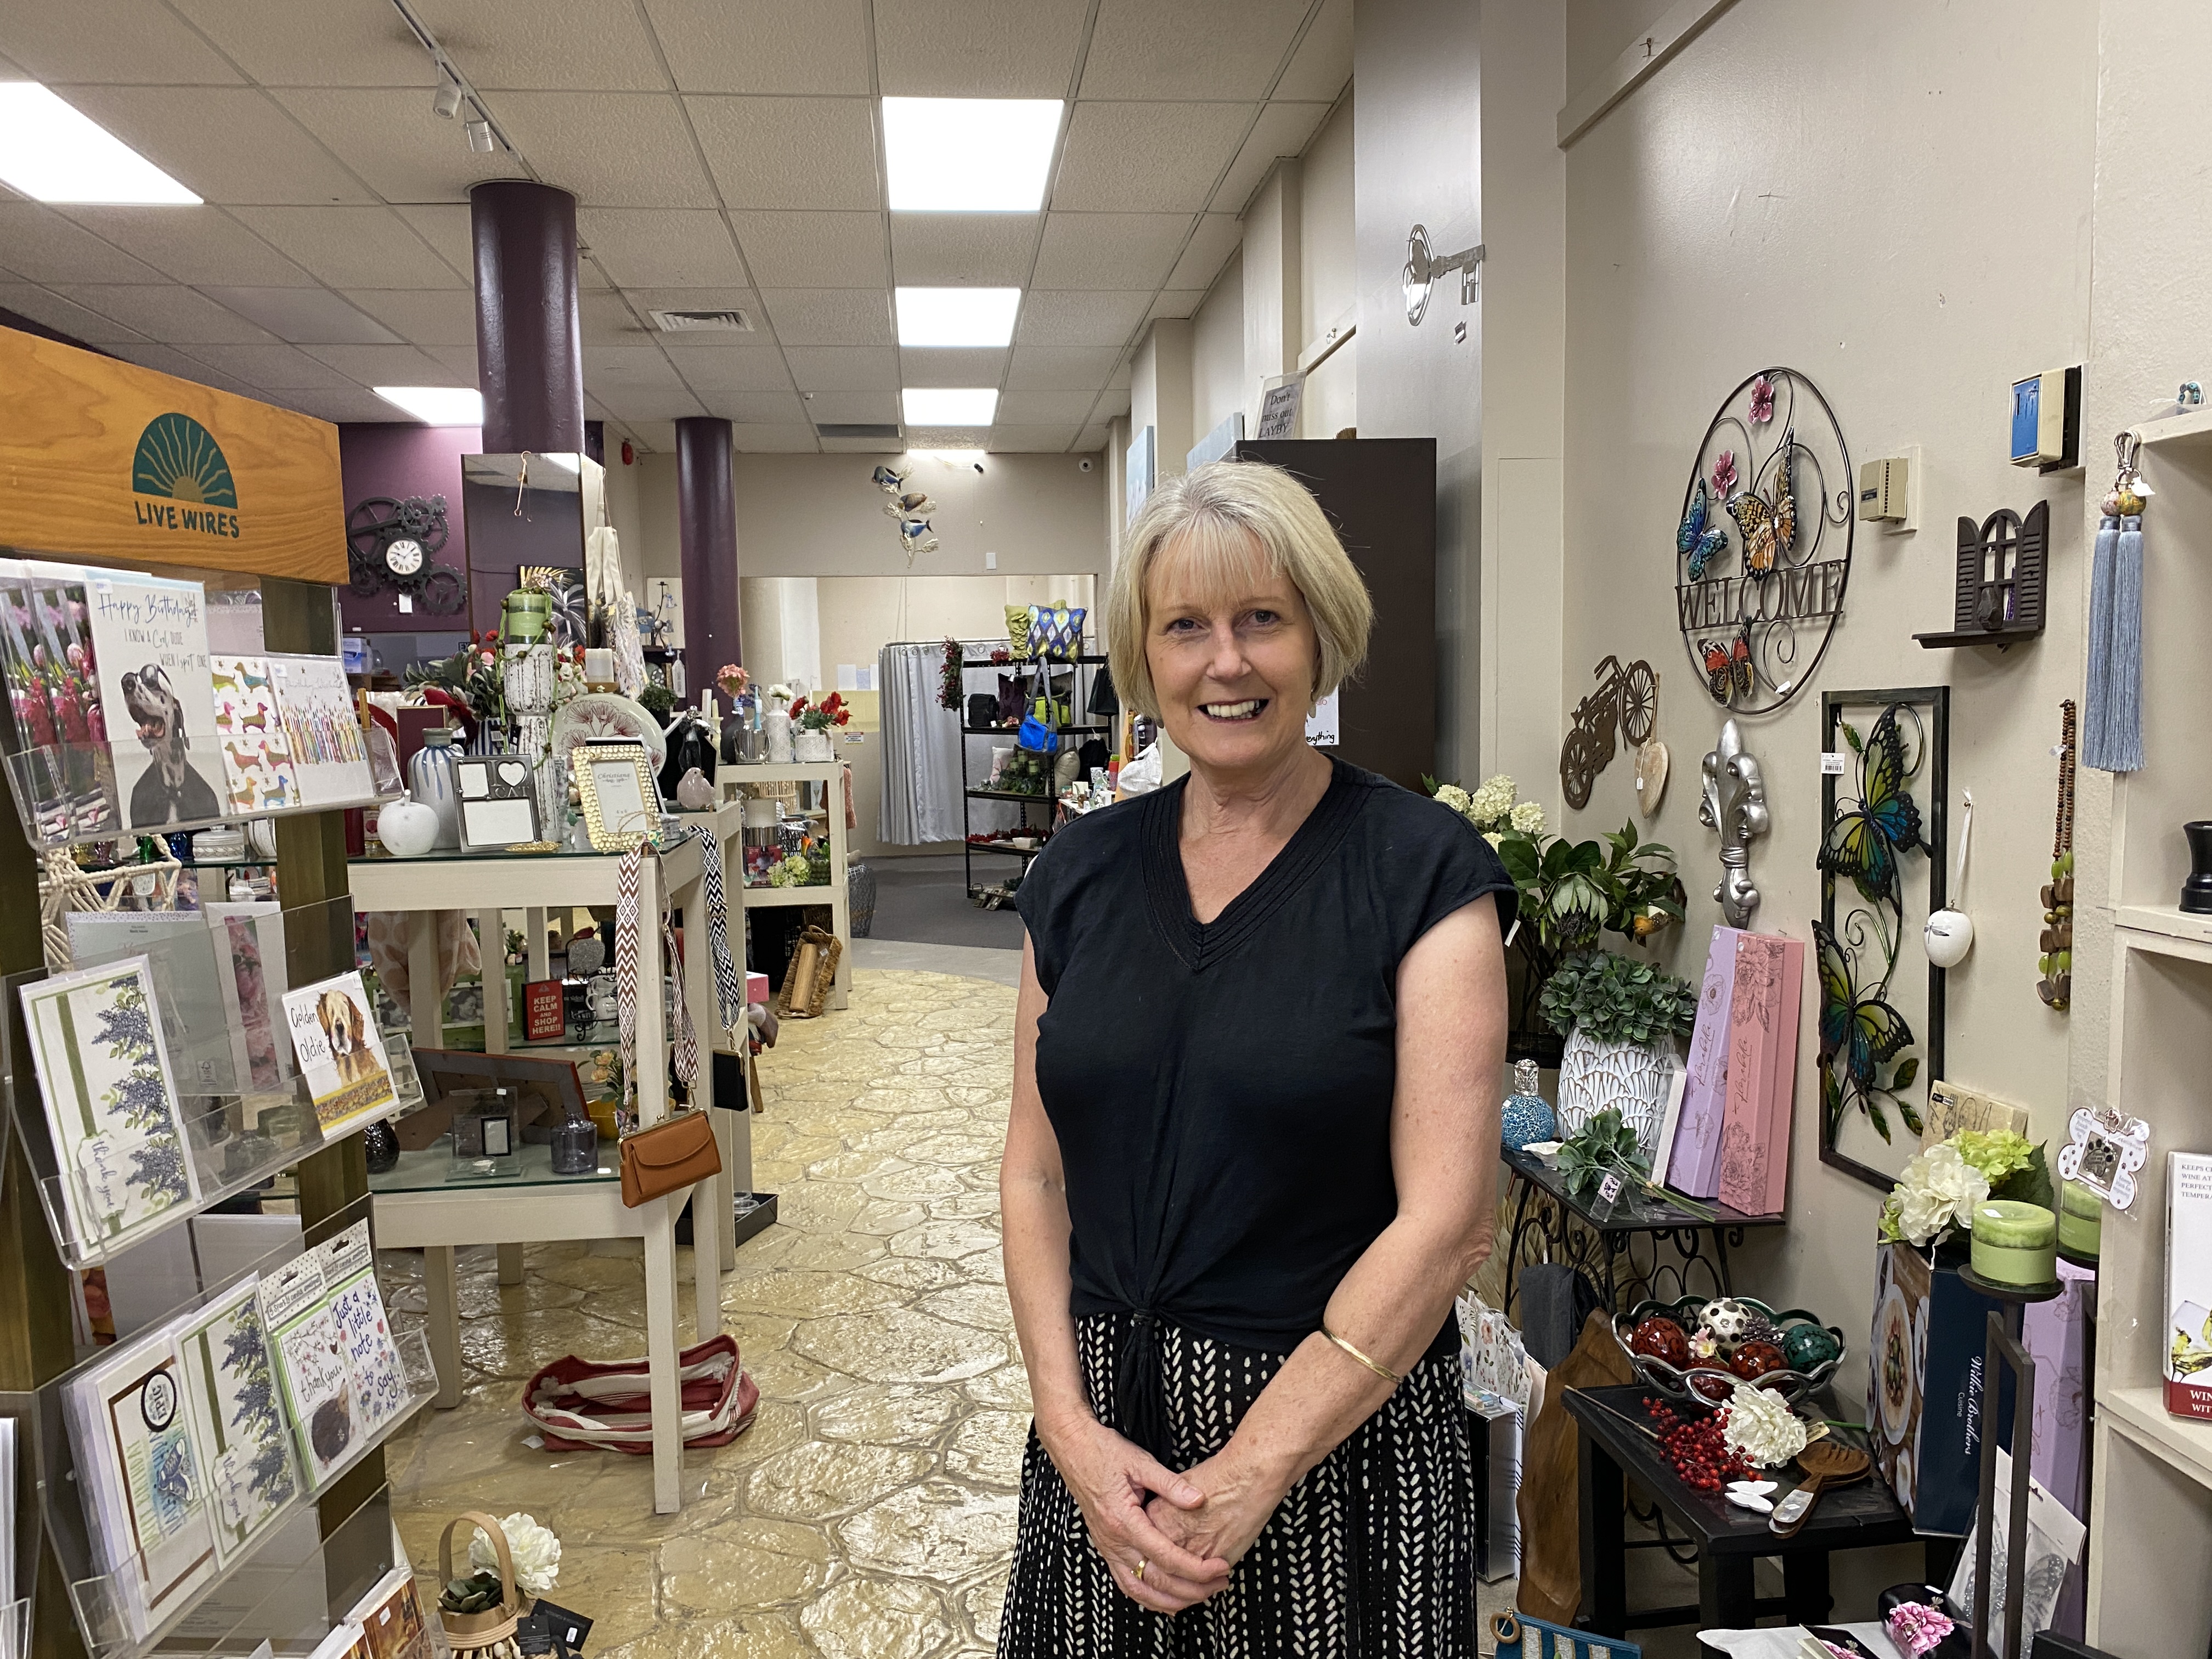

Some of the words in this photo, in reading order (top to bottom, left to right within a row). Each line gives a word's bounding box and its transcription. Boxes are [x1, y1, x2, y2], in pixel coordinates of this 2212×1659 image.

[1271, 392, 1290, 405] Don't
[1262, 411, 1278, 422] miss
[1280, 408, 1292, 418] out
[1259, 422, 1289, 438] LAYBY
[134, 501, 178, 529] LIVE
[182, 509, 239, 538] WIRES
[1674, 559, 1843, 631] WELCOME
[98, 594, 141, 624] Happy
[145, 595, 190, 628] Birthday
[125, 628, 127, 642] I
[129, 630, 144, 642] KNOW
[147, 630, 151, 642] A
[170, 631, 183, 645] DUDE
[160, 653, 174, 667] WHEN
[177, 654, 179, 666] I
[180, 654, 195, 673] spot
[197, 654, 207, 668] ONE
[1306, 730, 1335, 745] erything
[488, 760, 501, 787] I
[495, 786, 529, 798] CAT
[534, 995, 556, 1005] KEEP
[534, 1003, 557, 1012] CALM
[291, 1004, 319, 1028] Golden
[534, 1017, 557, 1026] SHOP
[532, 1024, 561, 1035] HERE!!
[300, 1036, 325, 1062] Oldie
[333, 1294, 352, 1329] Just
[353, 1291, 359, 1303] a
[348, 1306, 373, 1339] little
[351, 1333, 373, 1363] note
[301, 1367, 326, 1402] thank
[362, 1365, 374, 1386] to
[1969, 1356, 1984, 1396] Wilkie
[152, 1384, 167, 1420] EPIC
[1957, 1392, 1965, 1417] Cuisine
[1965, 1398, 1980, 1454] Brothers
